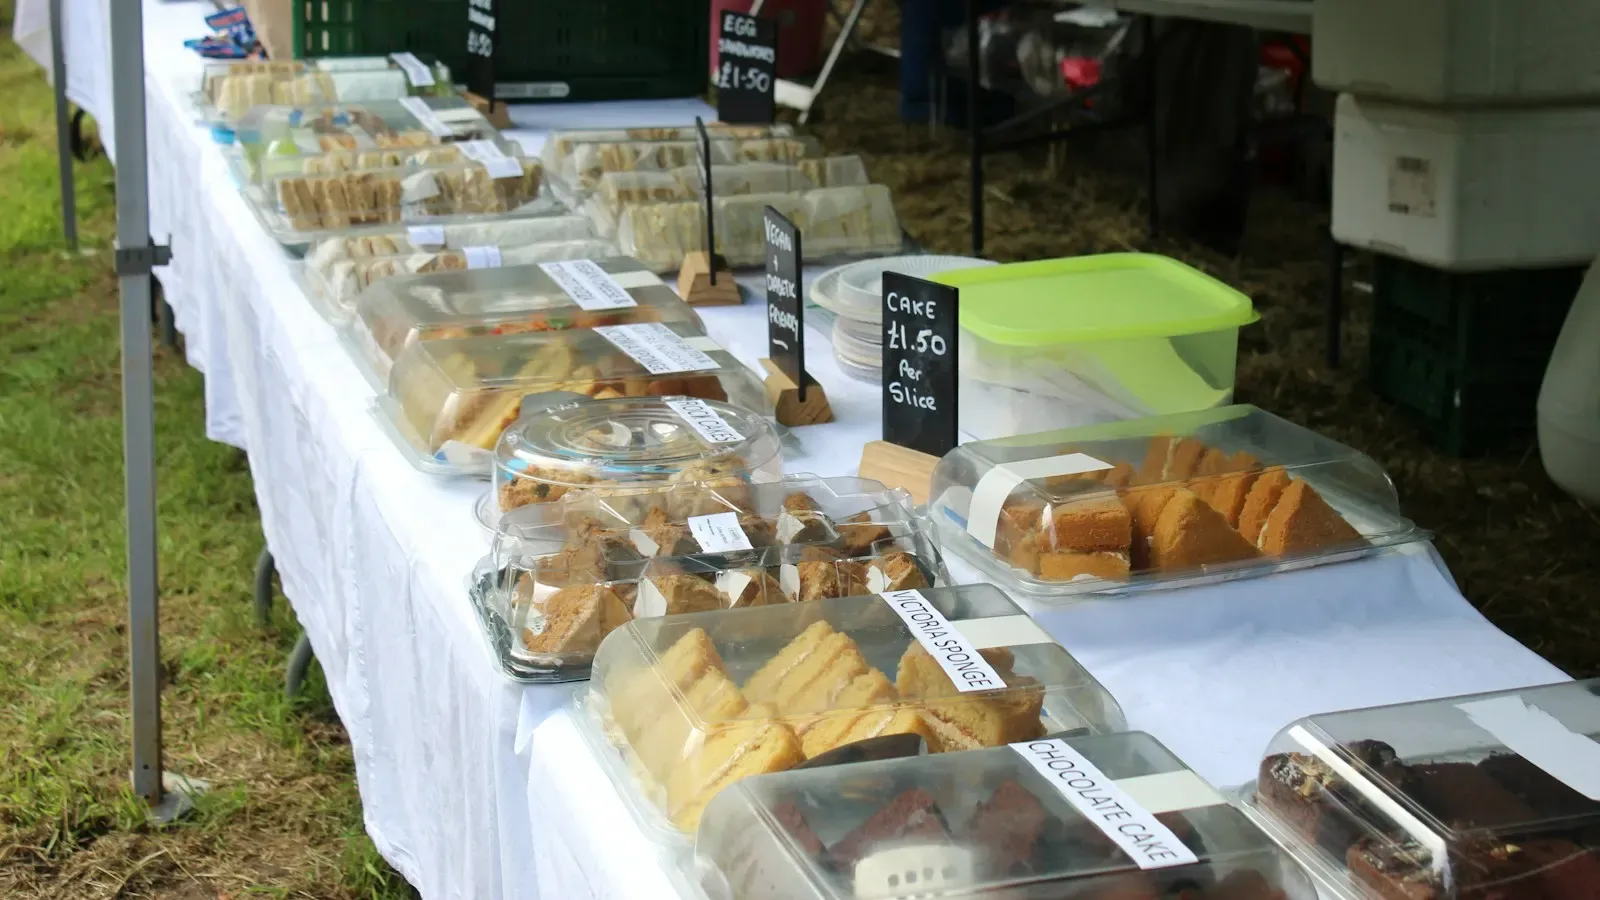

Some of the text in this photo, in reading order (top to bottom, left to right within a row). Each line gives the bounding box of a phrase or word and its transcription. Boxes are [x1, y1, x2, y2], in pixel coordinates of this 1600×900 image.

[723, 13, 757, 37] EGG
[764, 216, 792, 252] VEGAN
[768, 304, 799, 342] FRIENDLY
[887, 292, 937, 319] CAKE
[888, 320, 947, 355] £1.50
[899, 359, 923, 381] Per
[889, 382, 937, 411] Slice
[677, 401, 737, 441] ROCK CAKES
[892, 591, 993, 687] VICTORIA SPONGE
[1028, 741, 1179, 862] CHOCOLATE CAKE
